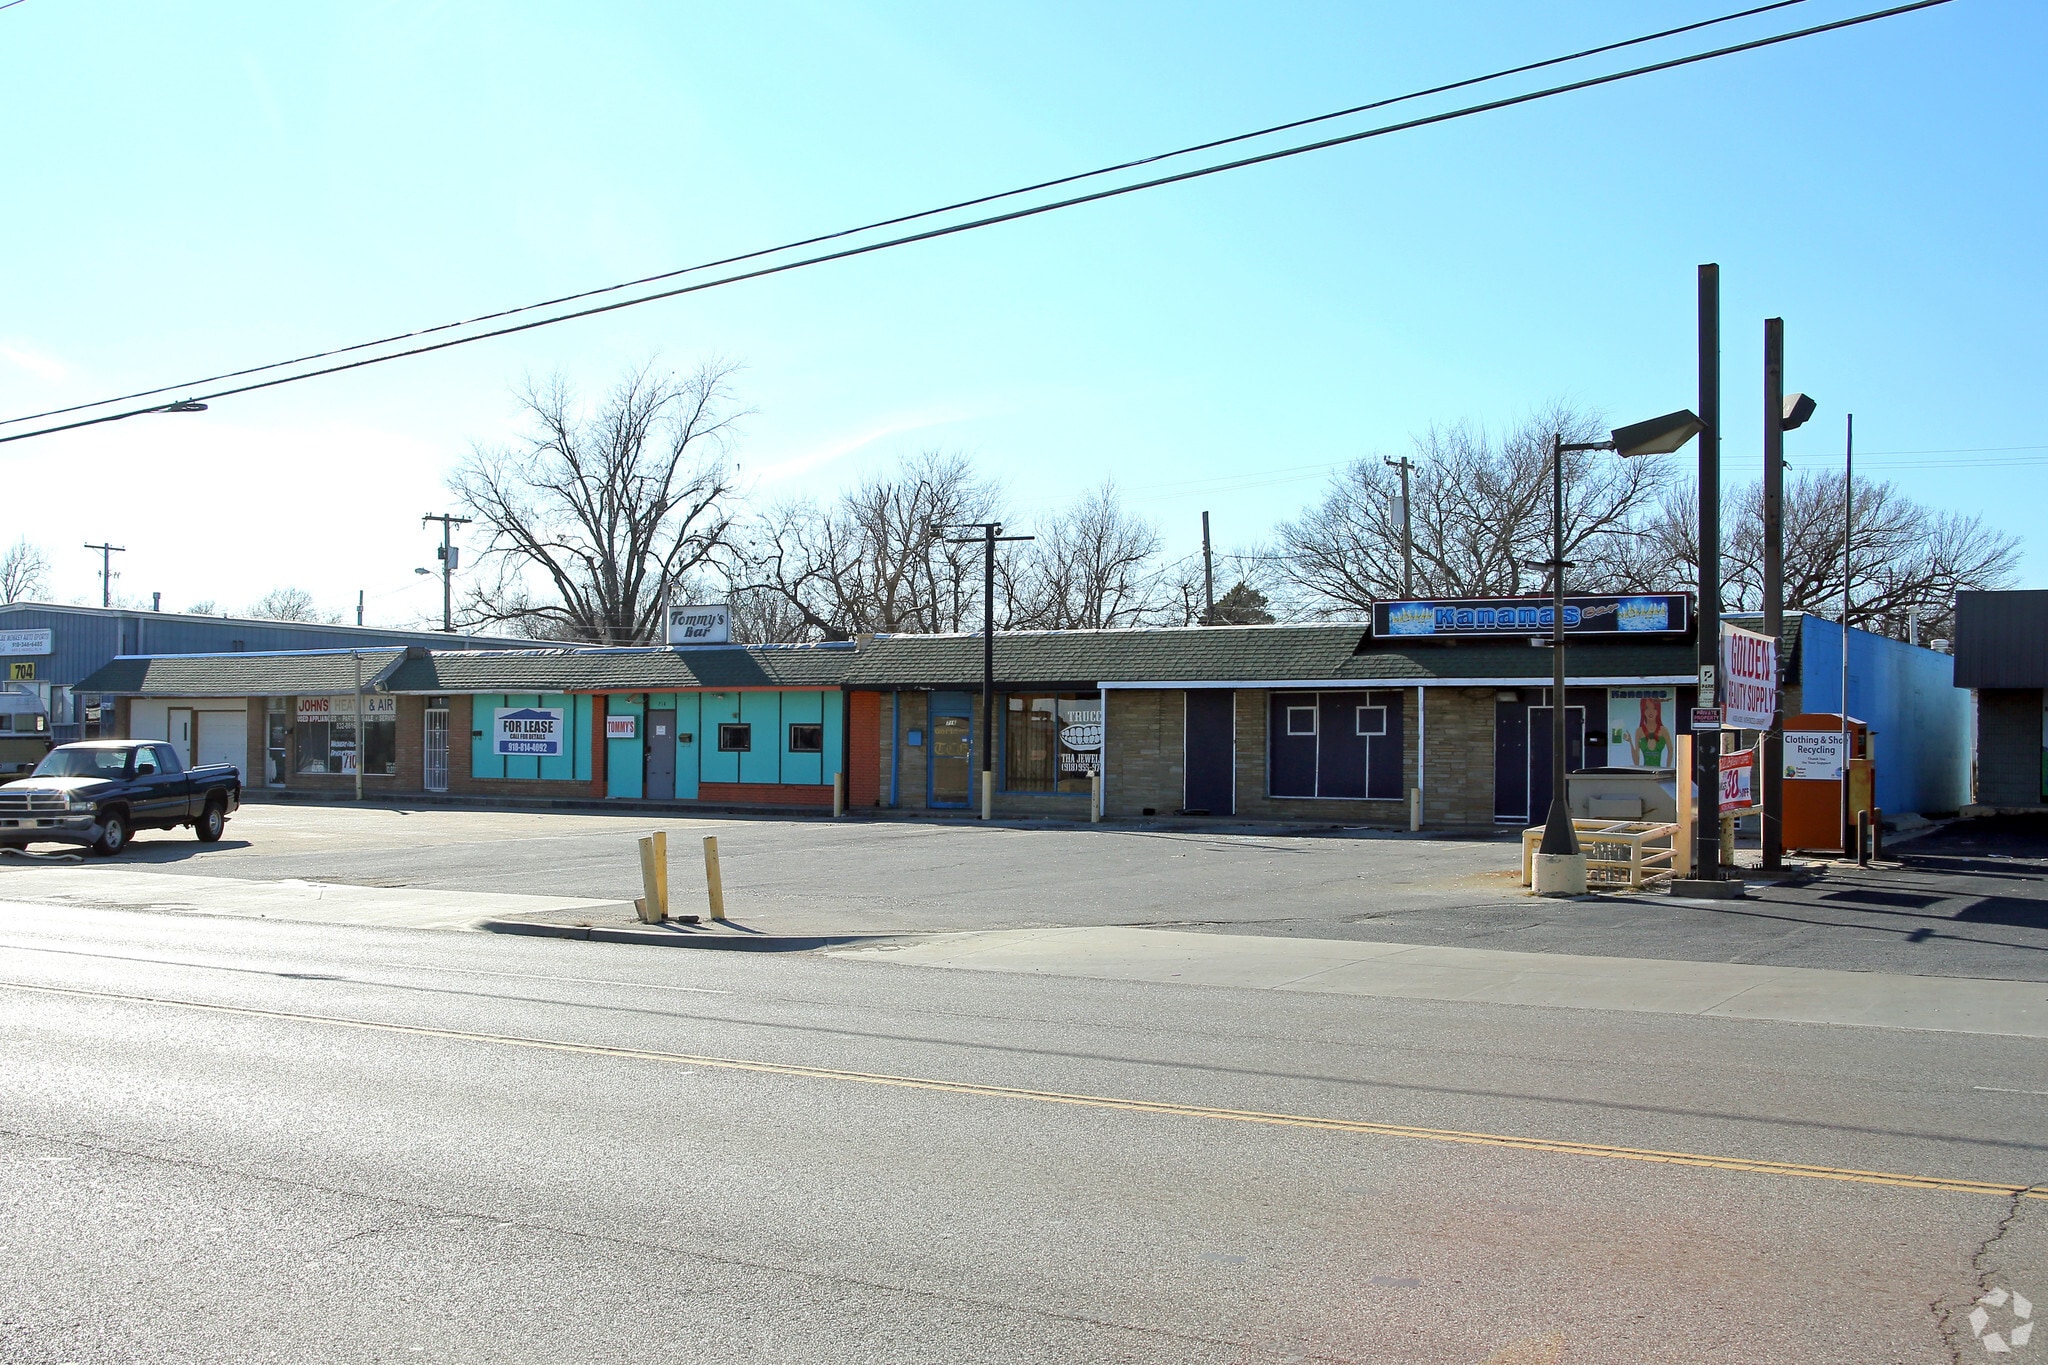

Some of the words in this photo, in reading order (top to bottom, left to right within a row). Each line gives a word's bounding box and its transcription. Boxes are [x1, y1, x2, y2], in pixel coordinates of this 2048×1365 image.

[670, 611, 725, 629] Tommy's
[1432, 606, 1581, 630] Kananas
[684, 627, 710, 638] Bar
[1731, 632, 1770, 681] GOLDEN
[15, 664, 34, 679] 704
[1728, 680, 1746, 711] BEAUTY
[1747, 684, 1774, 714] SUPPLY
[298, 698, 329, 712] JOHN'S
[368, 699, 376, 711] &
[377, 699, 394, 711] AIR
[1067, 710, 1101, 722] TRUCC
[503, 720, 521, 733] FOR
[524, 720, 554, 734] LEASE
[607, 720, 634, 733] TOMMY'S
[1784, 735, 1819, 746] Clothing
[1820, 735, 1827, 744] &
[1828, 735, 1848, 745] Sho
[1797, 745, 1836, 756] Recycling
[1061, 754, 1075, 763] THA
[1076, 754, 1101, 763] JEWEL
[1725, 769, 1740, 799] 30
